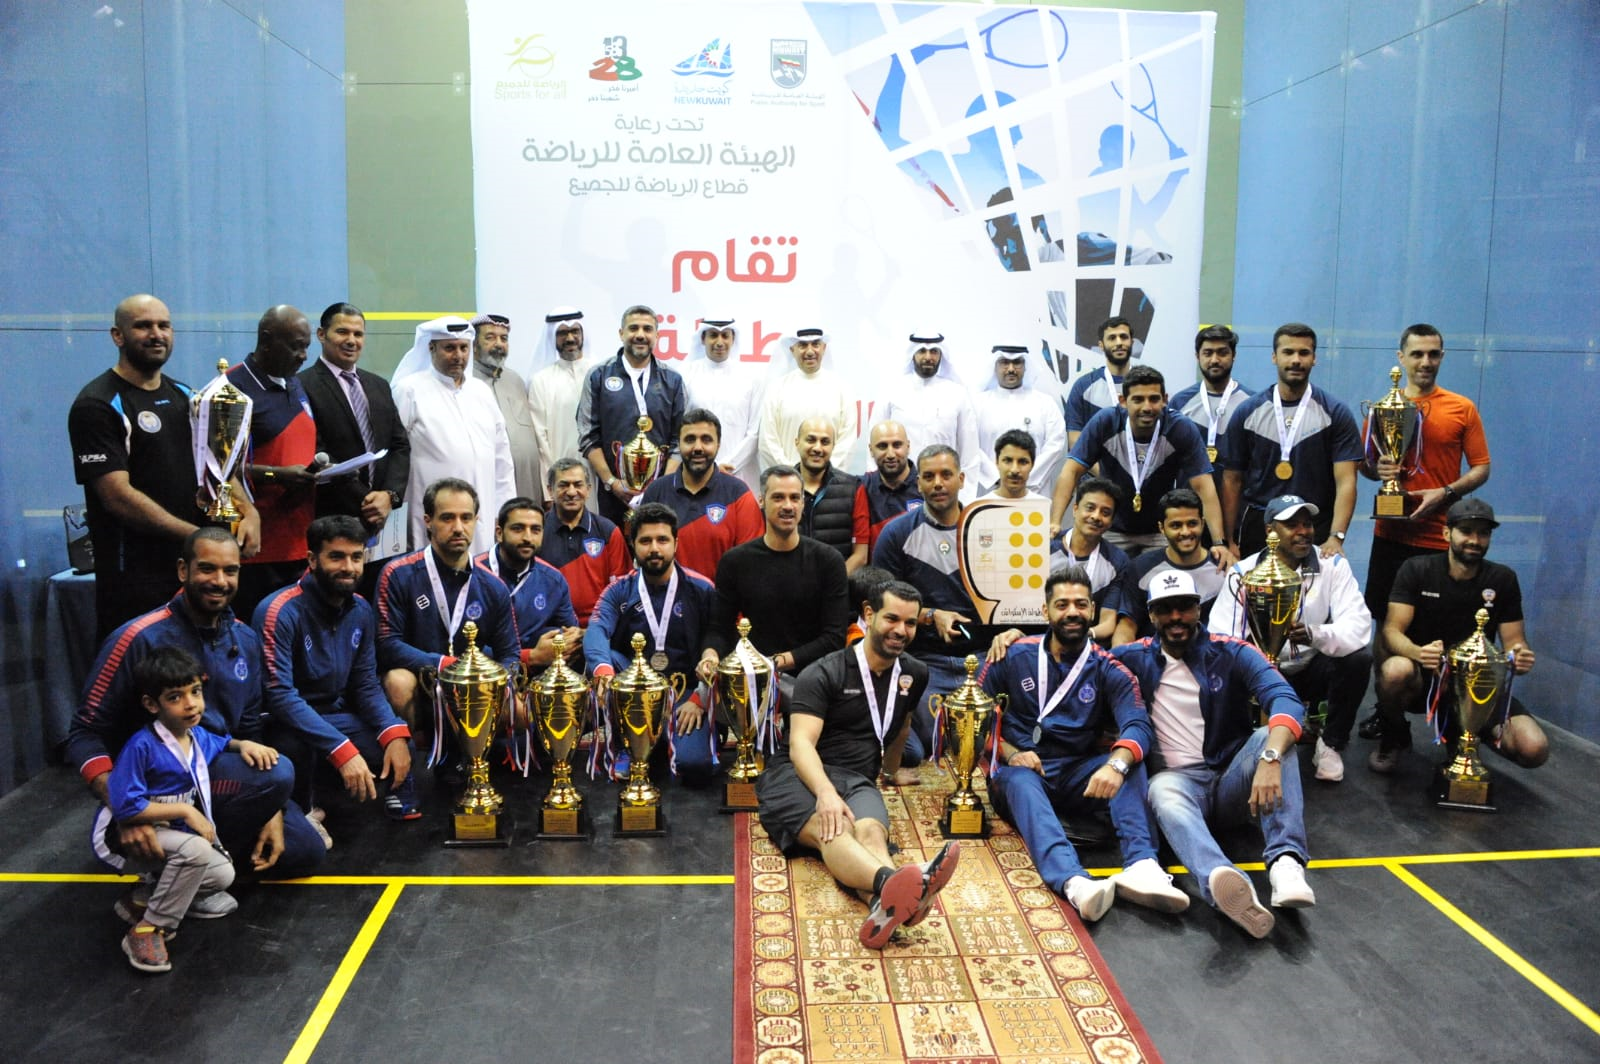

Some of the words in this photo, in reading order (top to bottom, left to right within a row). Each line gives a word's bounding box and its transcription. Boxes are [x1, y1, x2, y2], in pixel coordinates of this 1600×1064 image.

[614, 113, 661, 135] رعاية
[665, 115, 704, 132] تحت
[522, 137, 621, 169] للرياضة
[627, 140, 713, 167] العامة
[719, 142, 796, 174] الهيئة
[568, 177, 630, 197] للجميع
[634, 176, 699, 198] الرياضة
[703, 180, 749, 199] قطاع
[671, 235, 799, 294] تقام
